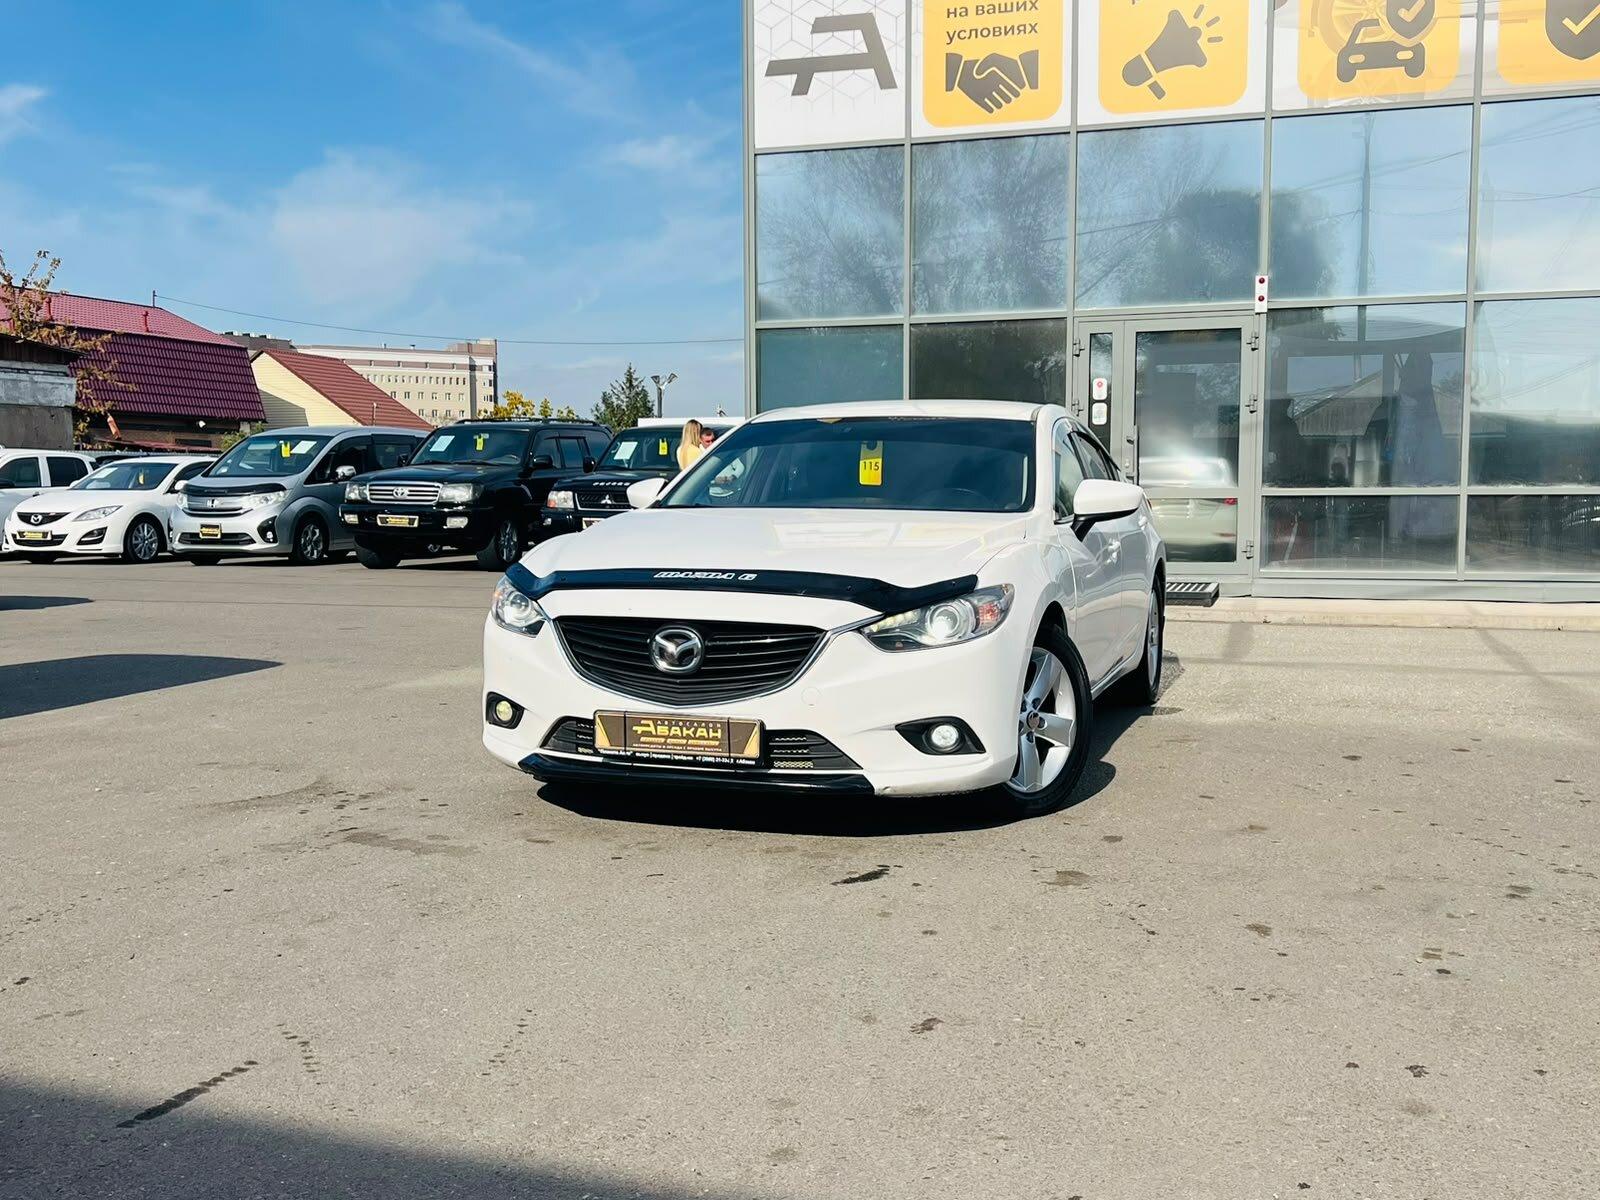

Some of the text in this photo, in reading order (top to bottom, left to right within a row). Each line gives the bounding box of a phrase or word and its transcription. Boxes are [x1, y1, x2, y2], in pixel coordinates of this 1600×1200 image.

[946, 0, 1039, 18] на ваших
[946, 22, 1039, 45] условиях
[862, 460, 880, 471] 115
